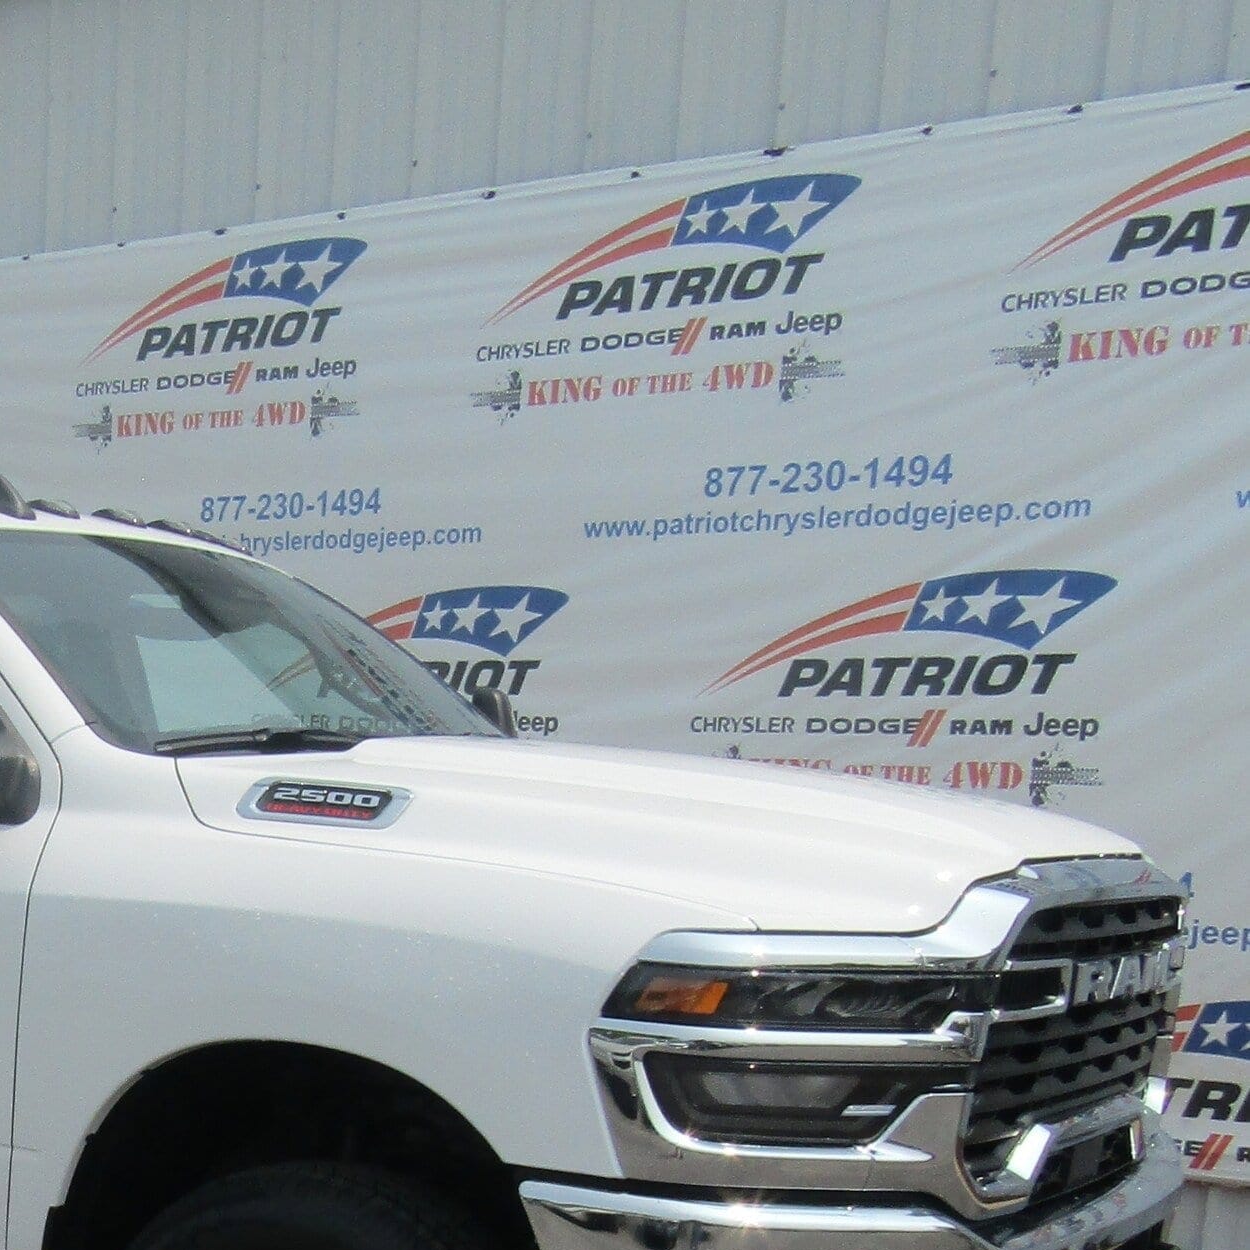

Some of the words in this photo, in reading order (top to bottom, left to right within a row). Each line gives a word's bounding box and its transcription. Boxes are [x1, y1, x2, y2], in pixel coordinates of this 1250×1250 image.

[556, 253, 825, 320] PATRIOT
[1001, 283, 1127, 313] CHRYSLER
[136, 306, 342, 361] PATRIOT
[477, 338, 570, 362] CHRYSLER
[580, 328, 684, 353] DODGE
[710, 320, 765, 341] RAM
[775, 311, 842, 335] Jeep
[1067, 326, 1169, 363] KING
[1183, 325, 1220, 349] OF
[75, 378, 149, 397] CHRYSLER
[156, 371, 234, 390] DODGE
[256, 366, 298, 382] RAM
[306, 357, 357, 380] Jeep
[527, 374, 603, 406] KING
[612, 377, 640, 396] OF
[645, 372, 693, 394] THE
[702, 361, 774, 392] 4WD
[116, 411, 175, 437] KING
[182, 411, 203, 430] OF
[209, 410, 244, 428] THE
[254, 400, 306, 427] 4WD
[704, 453, 953, 498] 877-230-1494
[201, 487, 381, 523] 877-230-1494
[584, 499, 1091, 540] www.patriotchryslerdodgejeep.com
[237, 525, 482, 557] hryslerdodgejeep.com
[777, 653, 1078, 697] PATRIOT
[513, 710, 558, 736] eep
[690, 716, 795, 735] CHRYSLER
[806, 717, 920, 735] DODGE
[950, 719, 1013, 736] RAM
[1023, 712, 1099, 742] Jeep
[943, 761, 1025, 790] 4WD
[273, 787, 382, 809] 2500
